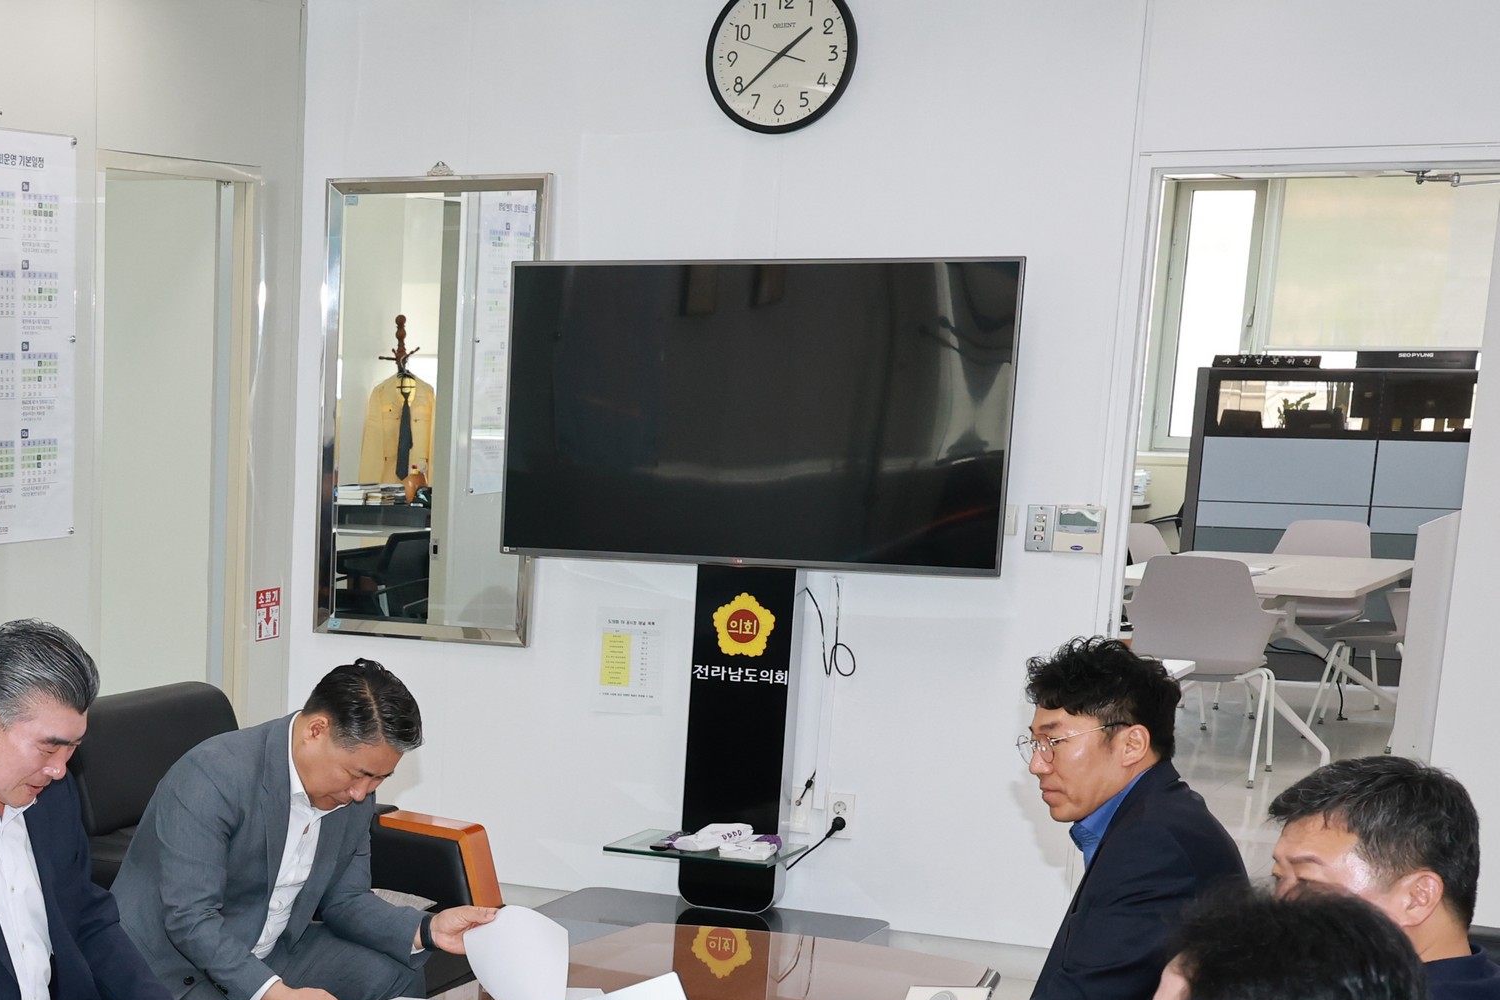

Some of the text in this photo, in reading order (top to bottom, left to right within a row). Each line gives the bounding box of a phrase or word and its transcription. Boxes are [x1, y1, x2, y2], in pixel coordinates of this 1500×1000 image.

[754, 3, 766, 19] 11
[808, 0, 813, 16] 1
[735, 24, 750, 41] 10
[823, 18, 834, 34] 2
[727, 51, 738, 67] 9
[828, 45, 838, 61] 3
[733, 76, 743, 93] 8
[817, 72, 828, 87] 4
[751, 94, 760, 109] 7
[774, 99, 784, 115] 6
[800, 91, 809, 107] 5
[19, 155, 44, 168] 기본일정
[259, 590, 278, 604] 소화기
[728, 619, 757, 635] 의회
[693, 665, 788, 685] 전라남도의회
